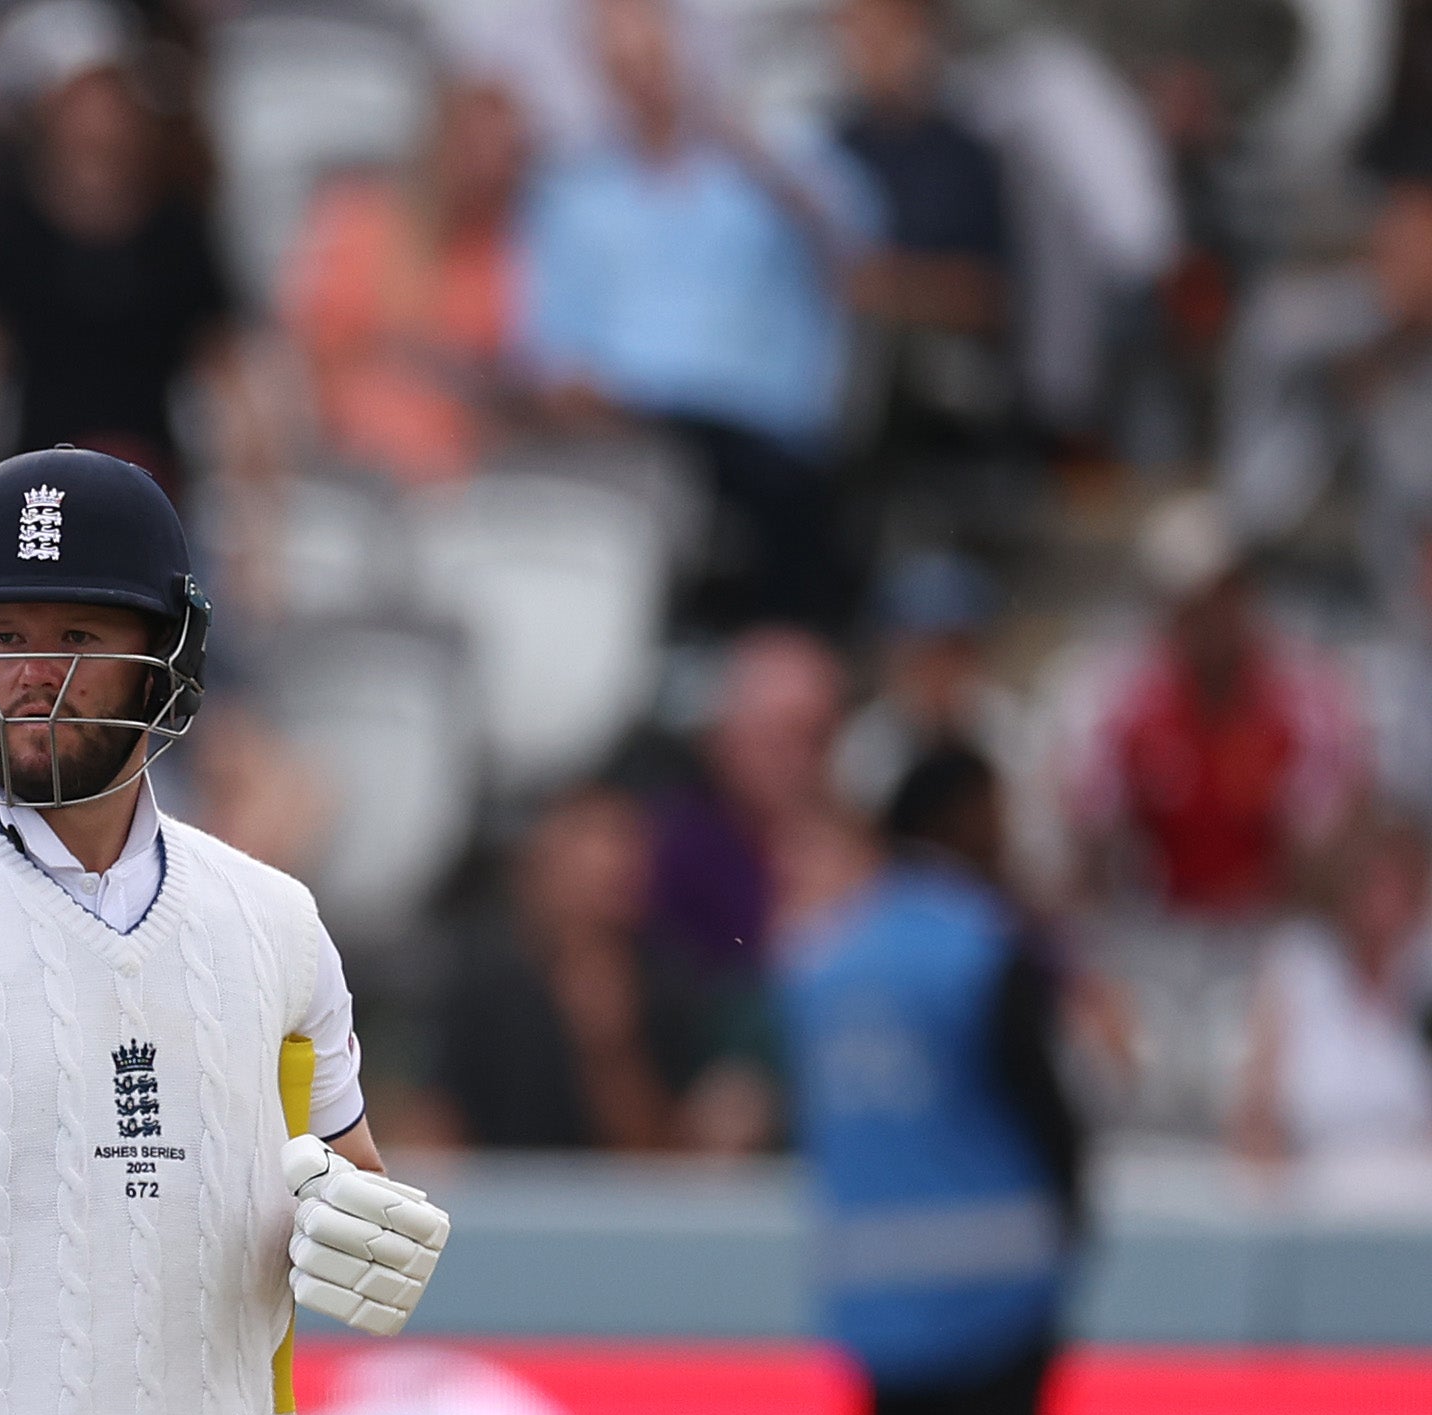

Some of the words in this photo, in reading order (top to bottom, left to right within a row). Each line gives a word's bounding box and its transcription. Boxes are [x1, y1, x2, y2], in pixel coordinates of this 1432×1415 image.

[94, 1146, 138, 1159] ASHES
[141, 1146, 186, 1160] SERIES
[126, 1162, 156, 1174] 2023
[125, 1181, 160, 1198] 672
